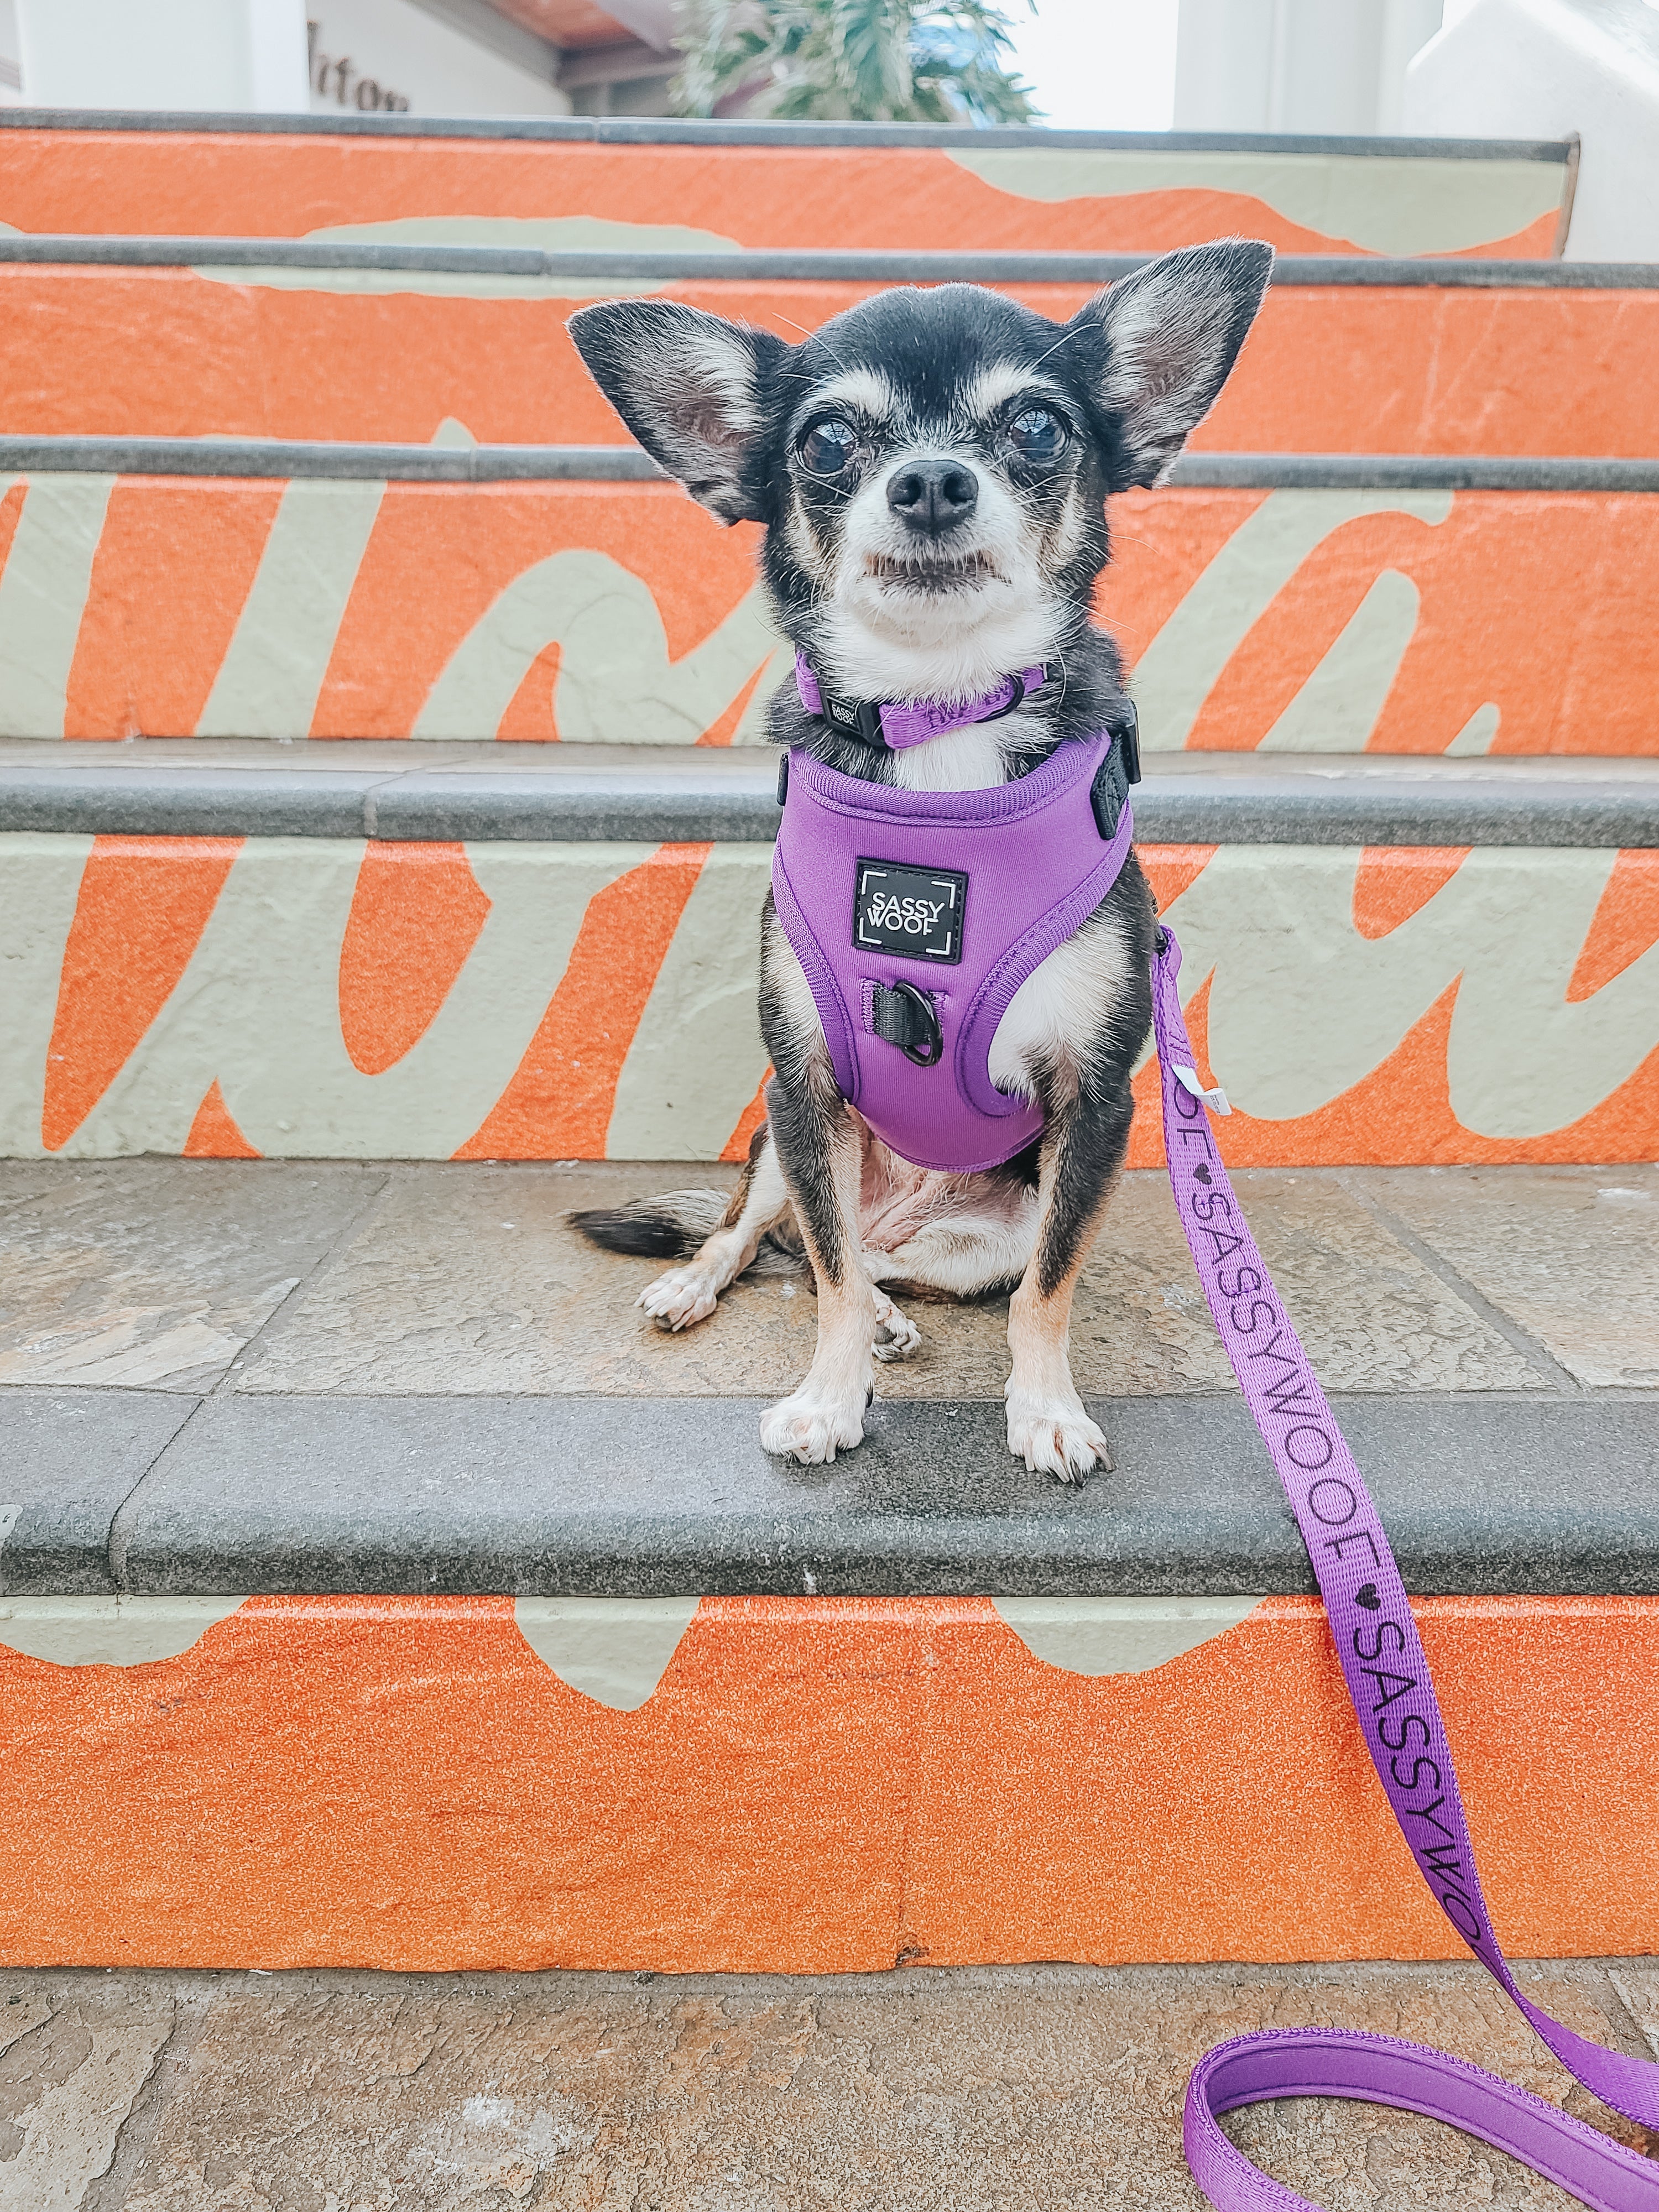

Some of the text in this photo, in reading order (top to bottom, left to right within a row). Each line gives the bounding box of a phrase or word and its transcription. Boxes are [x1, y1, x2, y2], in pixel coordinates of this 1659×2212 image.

[872, 891, 946, 919] SASSY
[866, 907, 939, 936] WOOF
[1192, 1192, 1381, 1567] SASSYWOOF
